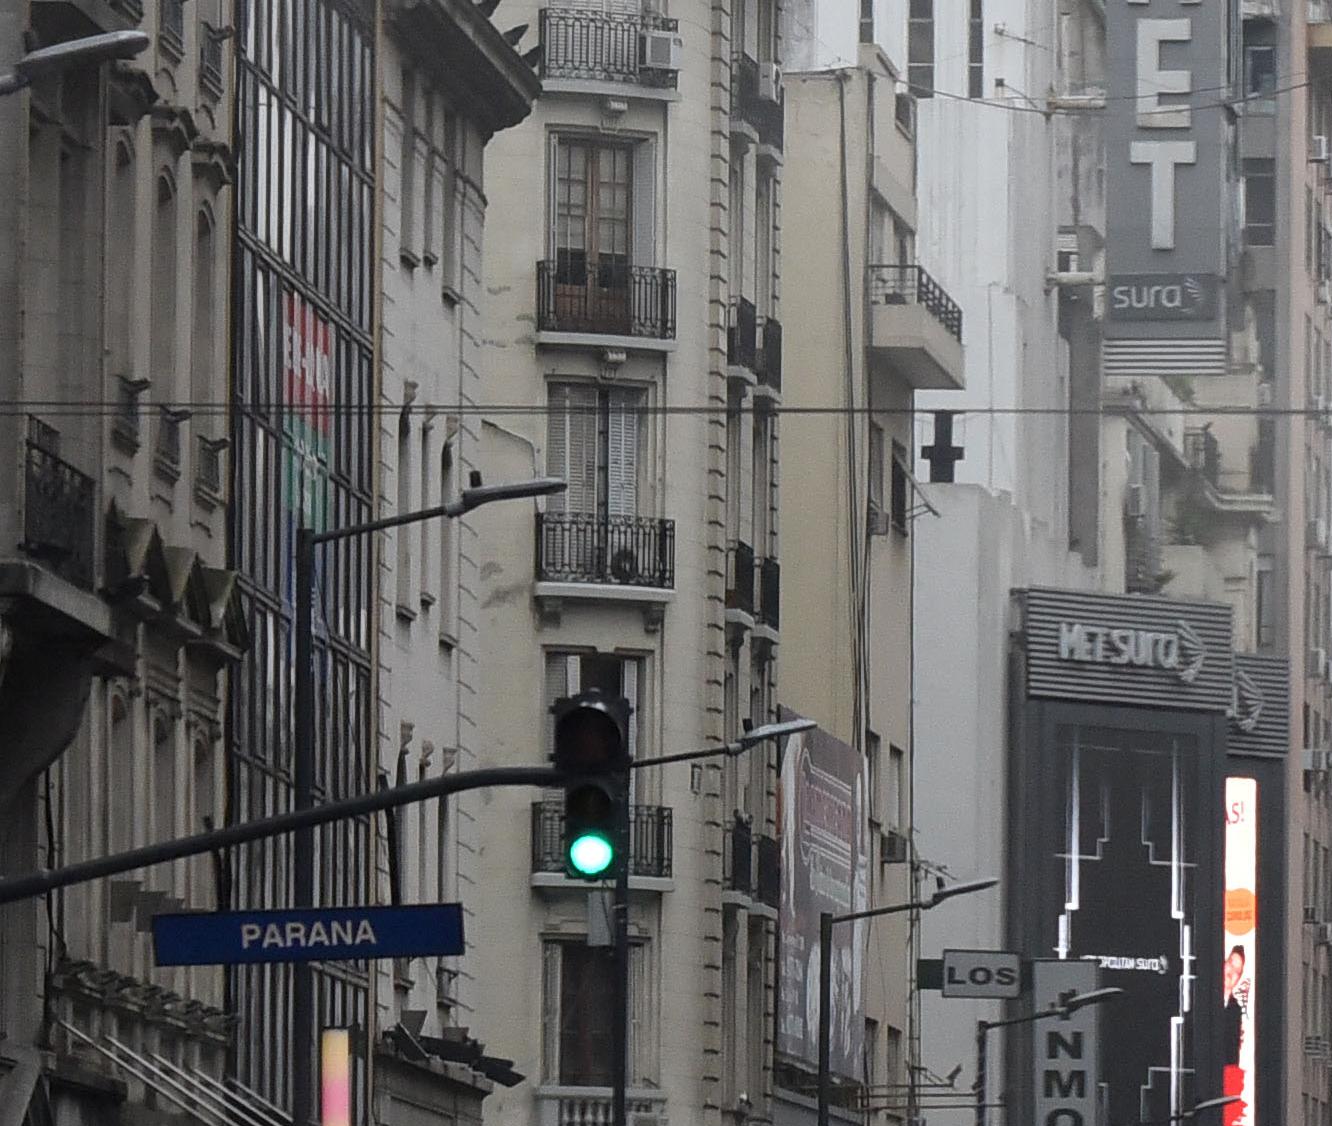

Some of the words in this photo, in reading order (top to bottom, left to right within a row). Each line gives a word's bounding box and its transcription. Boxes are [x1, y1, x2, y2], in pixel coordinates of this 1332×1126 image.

[1128, 0, 1197, 250] ET
[1113, 284, 1182, 309] sura
[241, 921, 377, 949] PARANA
[946, 966, 1016, 987] LOS
